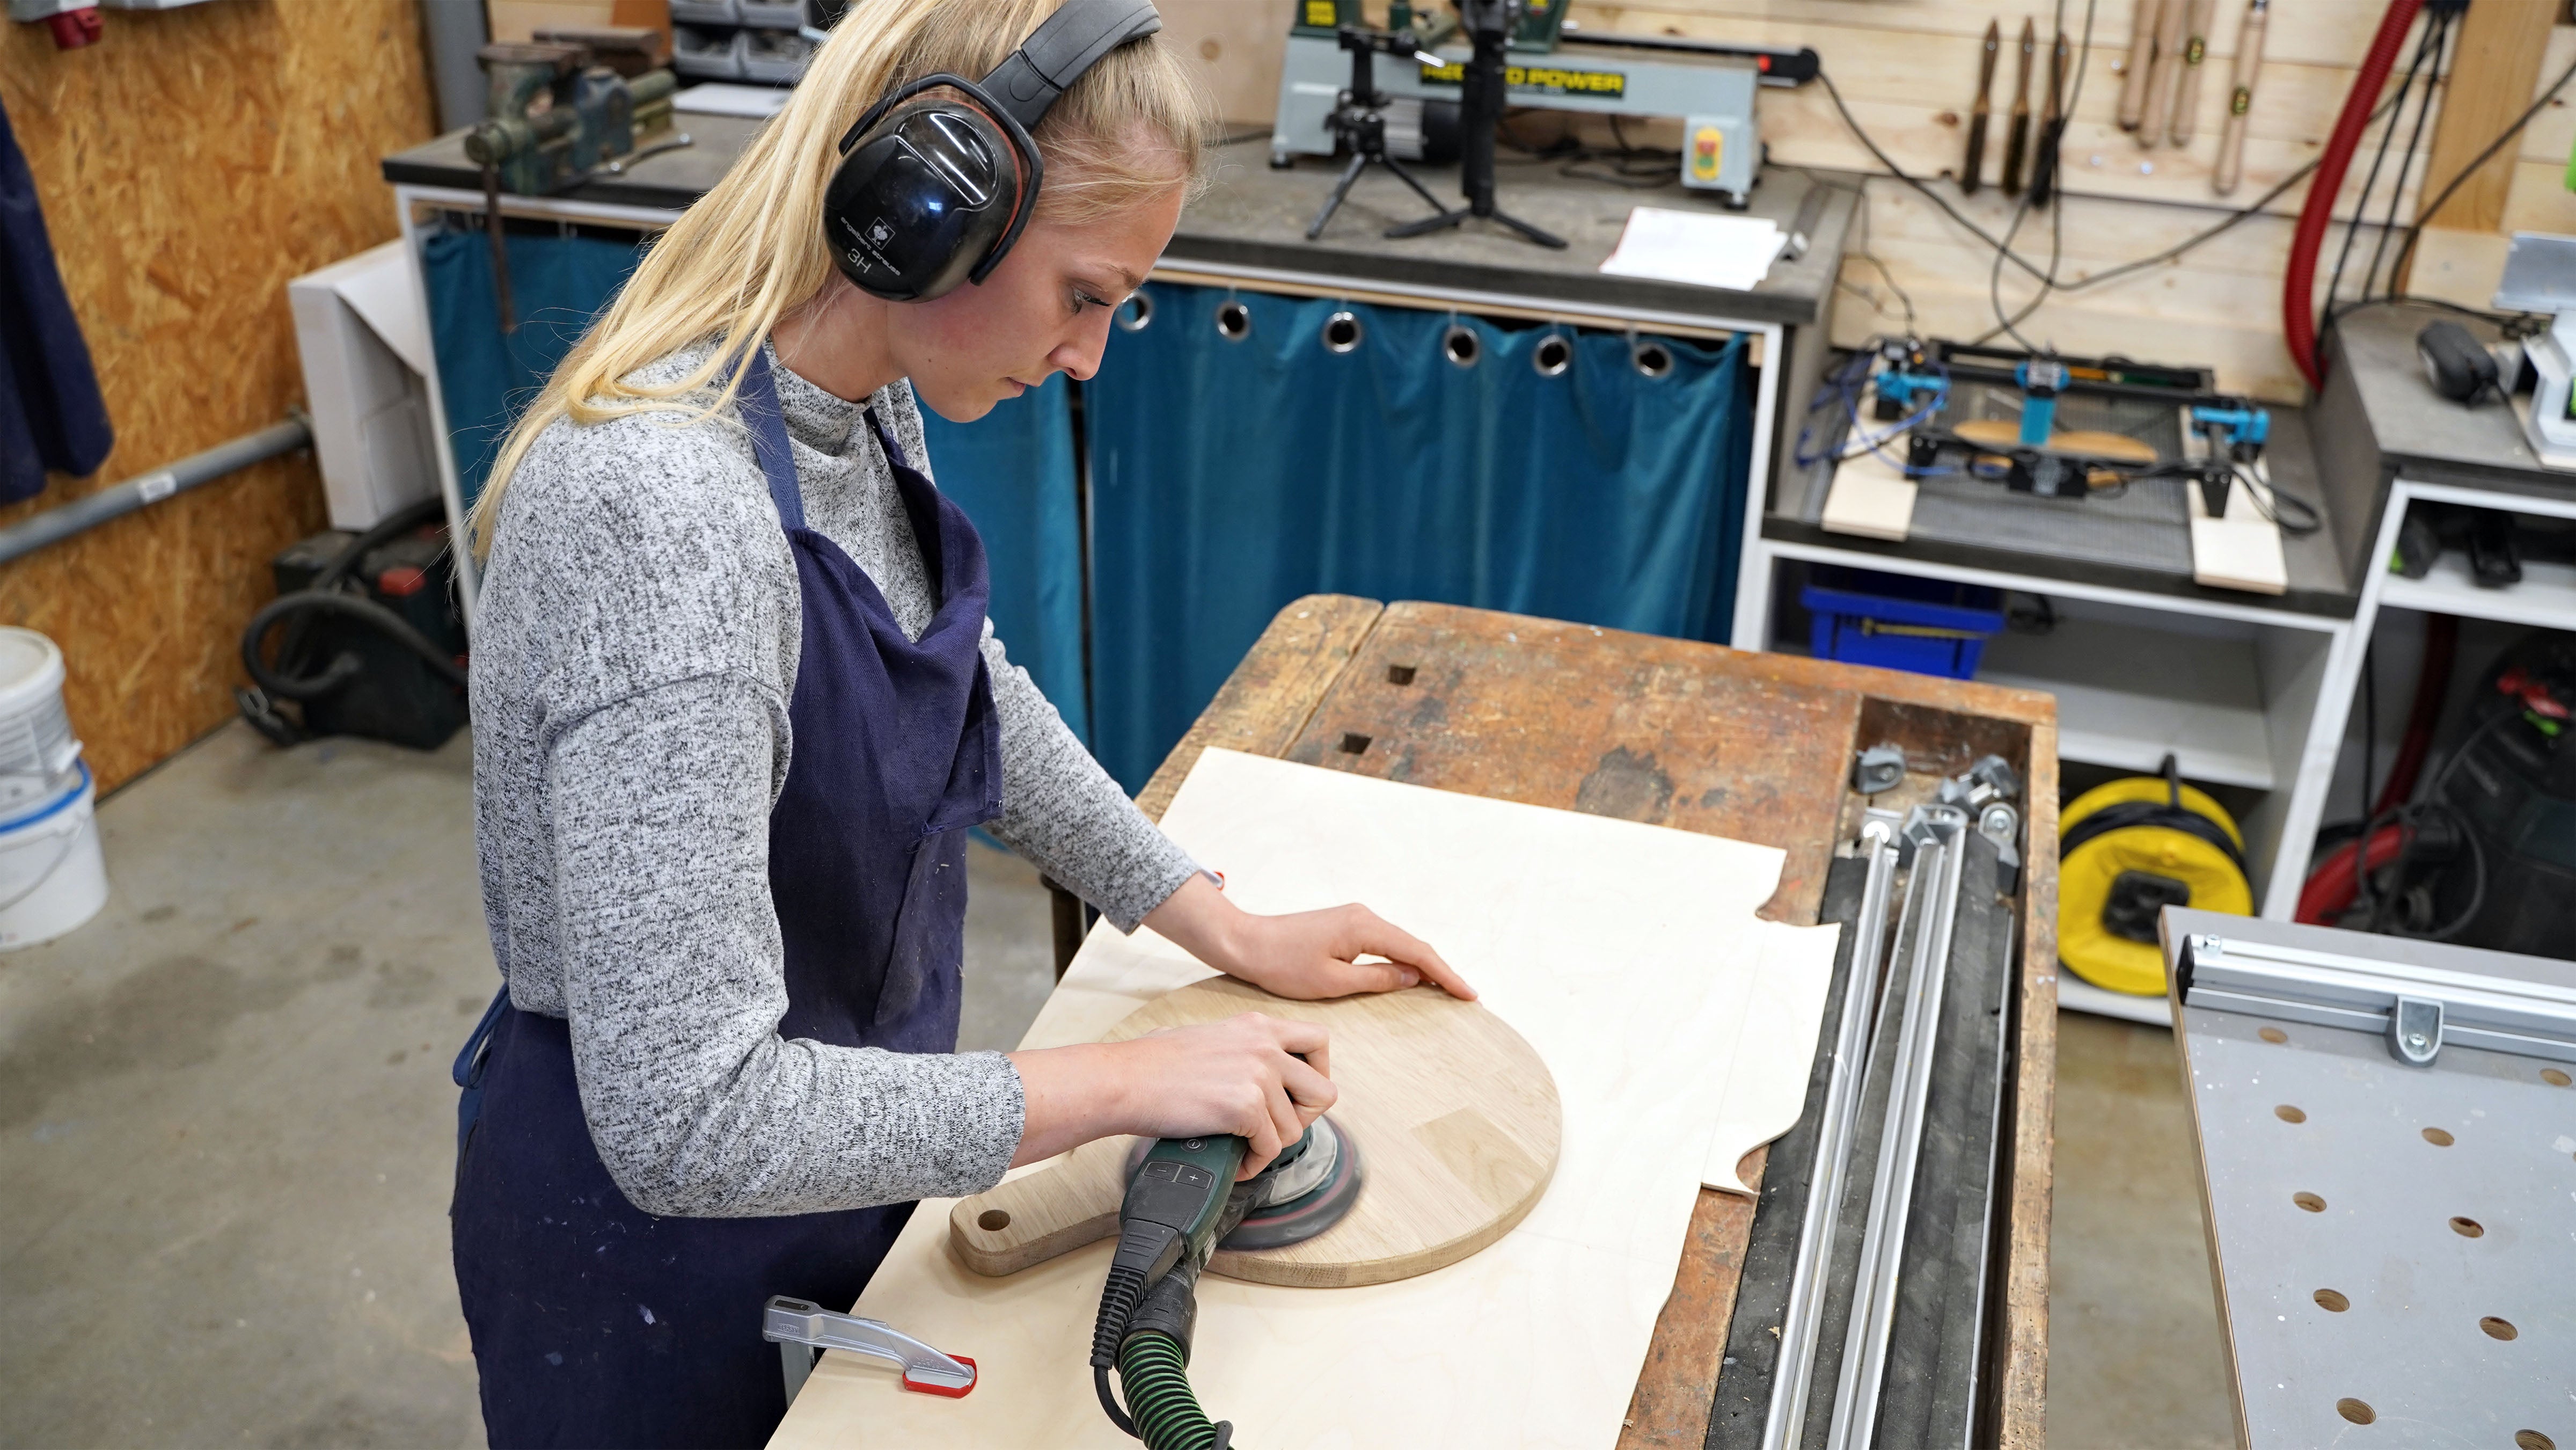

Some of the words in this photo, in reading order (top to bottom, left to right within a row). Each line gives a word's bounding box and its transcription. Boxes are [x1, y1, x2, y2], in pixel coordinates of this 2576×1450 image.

[1528, 67, 1624, 92] POWER
[840, 216, 872, 250] engelbert
[872, 250, 901, 276] strauss
[848, 248, 872, 273] 3H
